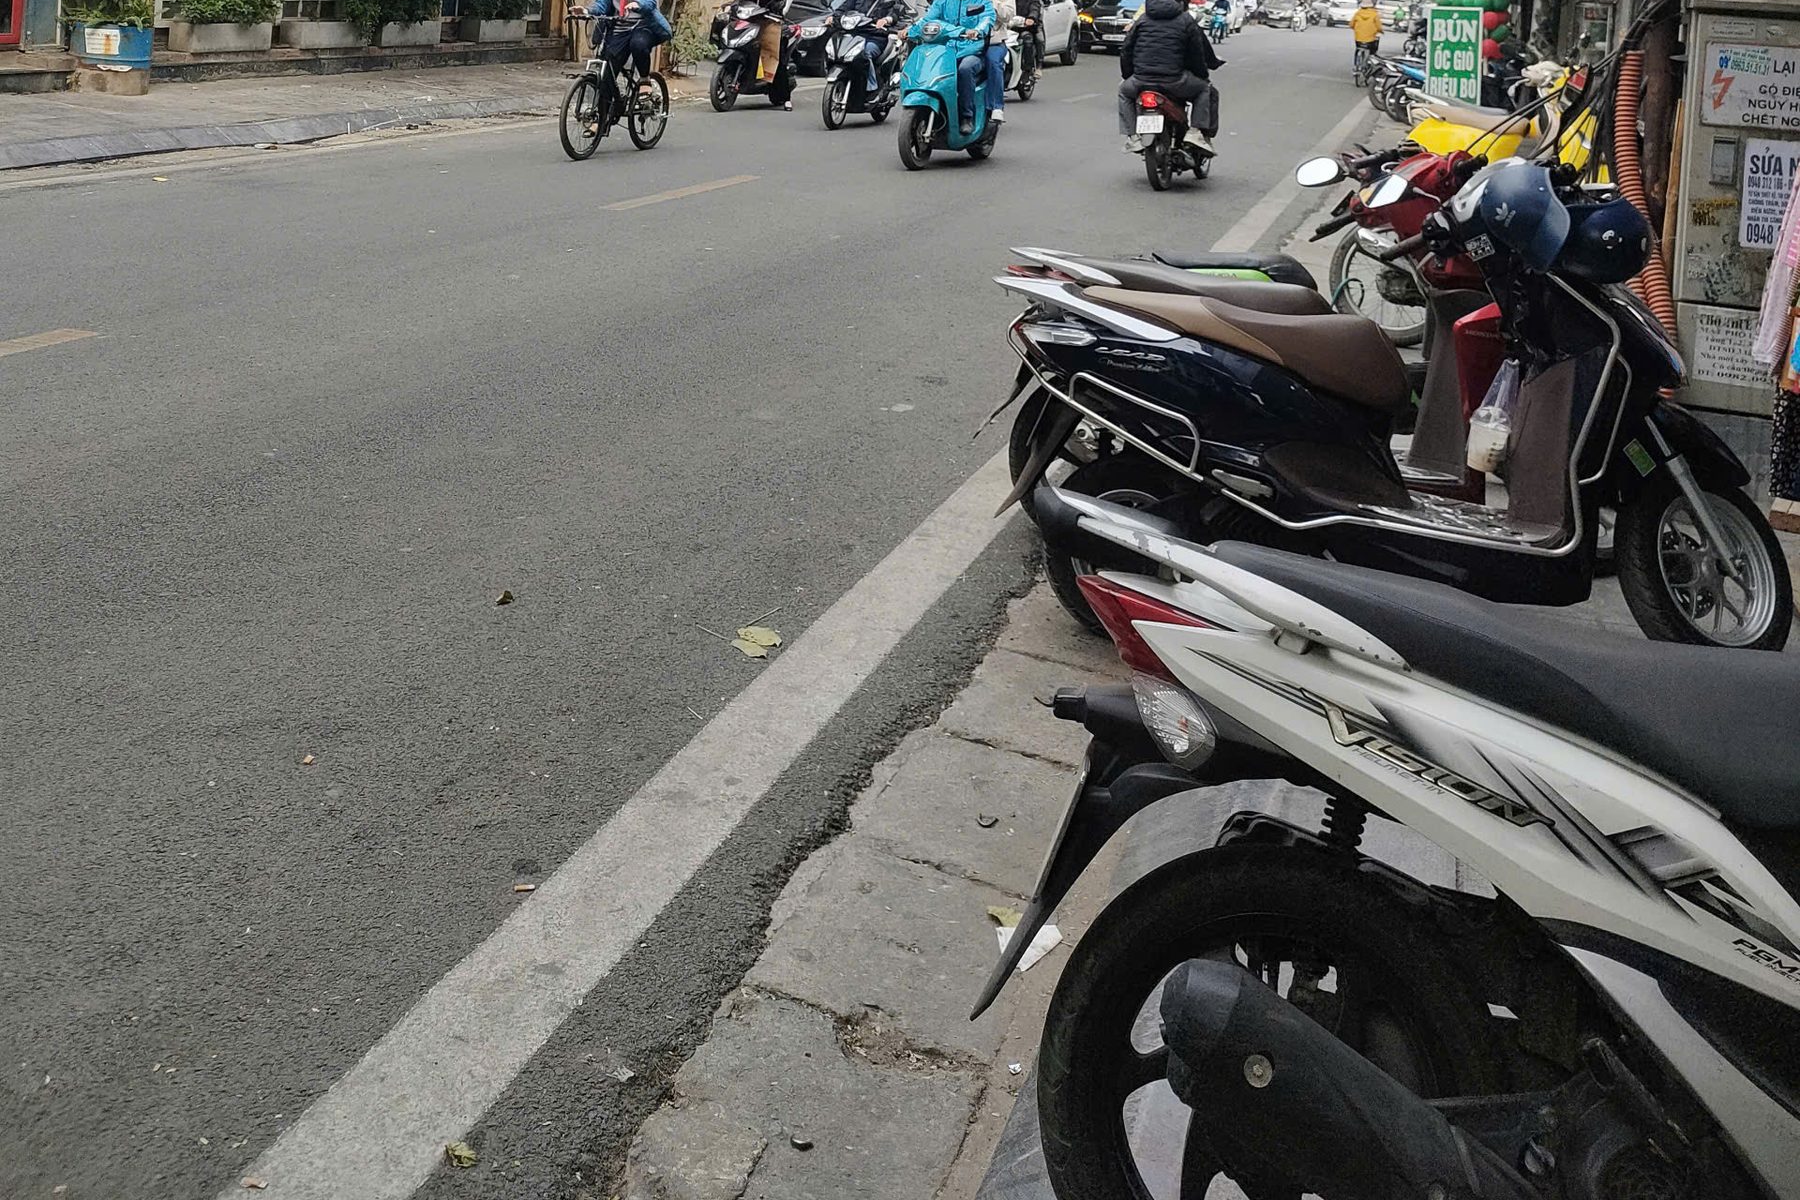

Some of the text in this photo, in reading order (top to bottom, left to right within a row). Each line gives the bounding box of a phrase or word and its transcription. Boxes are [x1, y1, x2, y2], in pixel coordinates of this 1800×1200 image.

[1432, 12, 1478, 43] BÚN
[1433, 43, 1475, 71] ỐC GIÒ
[1773, 60, 1795, 77] LẠI
[1460, 73, 1477, 99] BÒ
[1748, 98, 1786, 111] NGUY
[1749, 146, 1783, 176] SỬA
[1746, 223, 1774, 245] 0948
[1318, 698, 1556, 827] VISION
[1351, 747, 1446, 796] HELMET-IN
